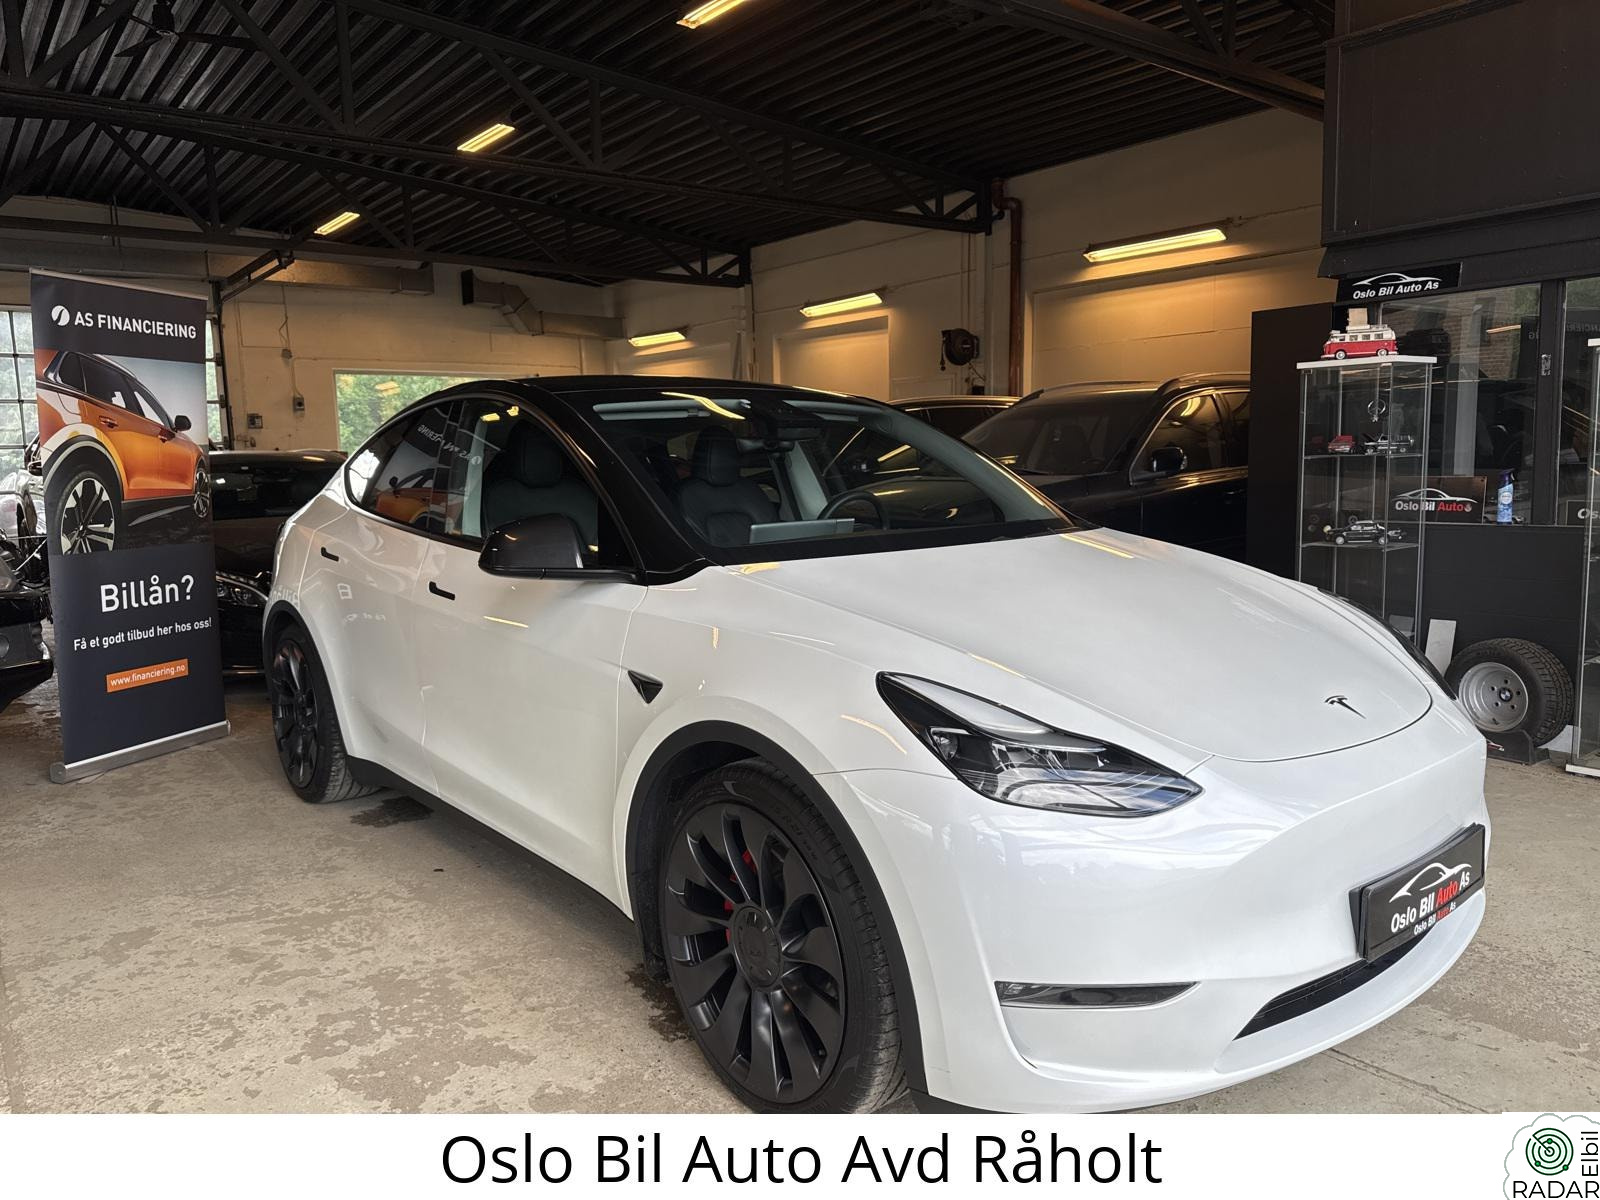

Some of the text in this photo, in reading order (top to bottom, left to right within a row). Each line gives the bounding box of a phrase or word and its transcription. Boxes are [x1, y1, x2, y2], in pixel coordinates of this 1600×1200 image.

[1353, 281, 1439, 299] Oslo Bil Auto As
[74, 311, 197, 339] AS FINANCIERING
[1395, 501, 1419, 511] Oslo
[1421, 501, 1435, 511] Bil
[1438, 501, 1464, 511] Auto
[100, 574, 195, 613] Billån?
[73, 617, 212, 651] Få et godt tilbud her hos oss!
[110, 664, 186, 687] www.financiering.no
[1391, 906, 1417, 933] Oslo
[1436, 881, 1459, 906] Auto
[1460, 871, 1470, 890] As
